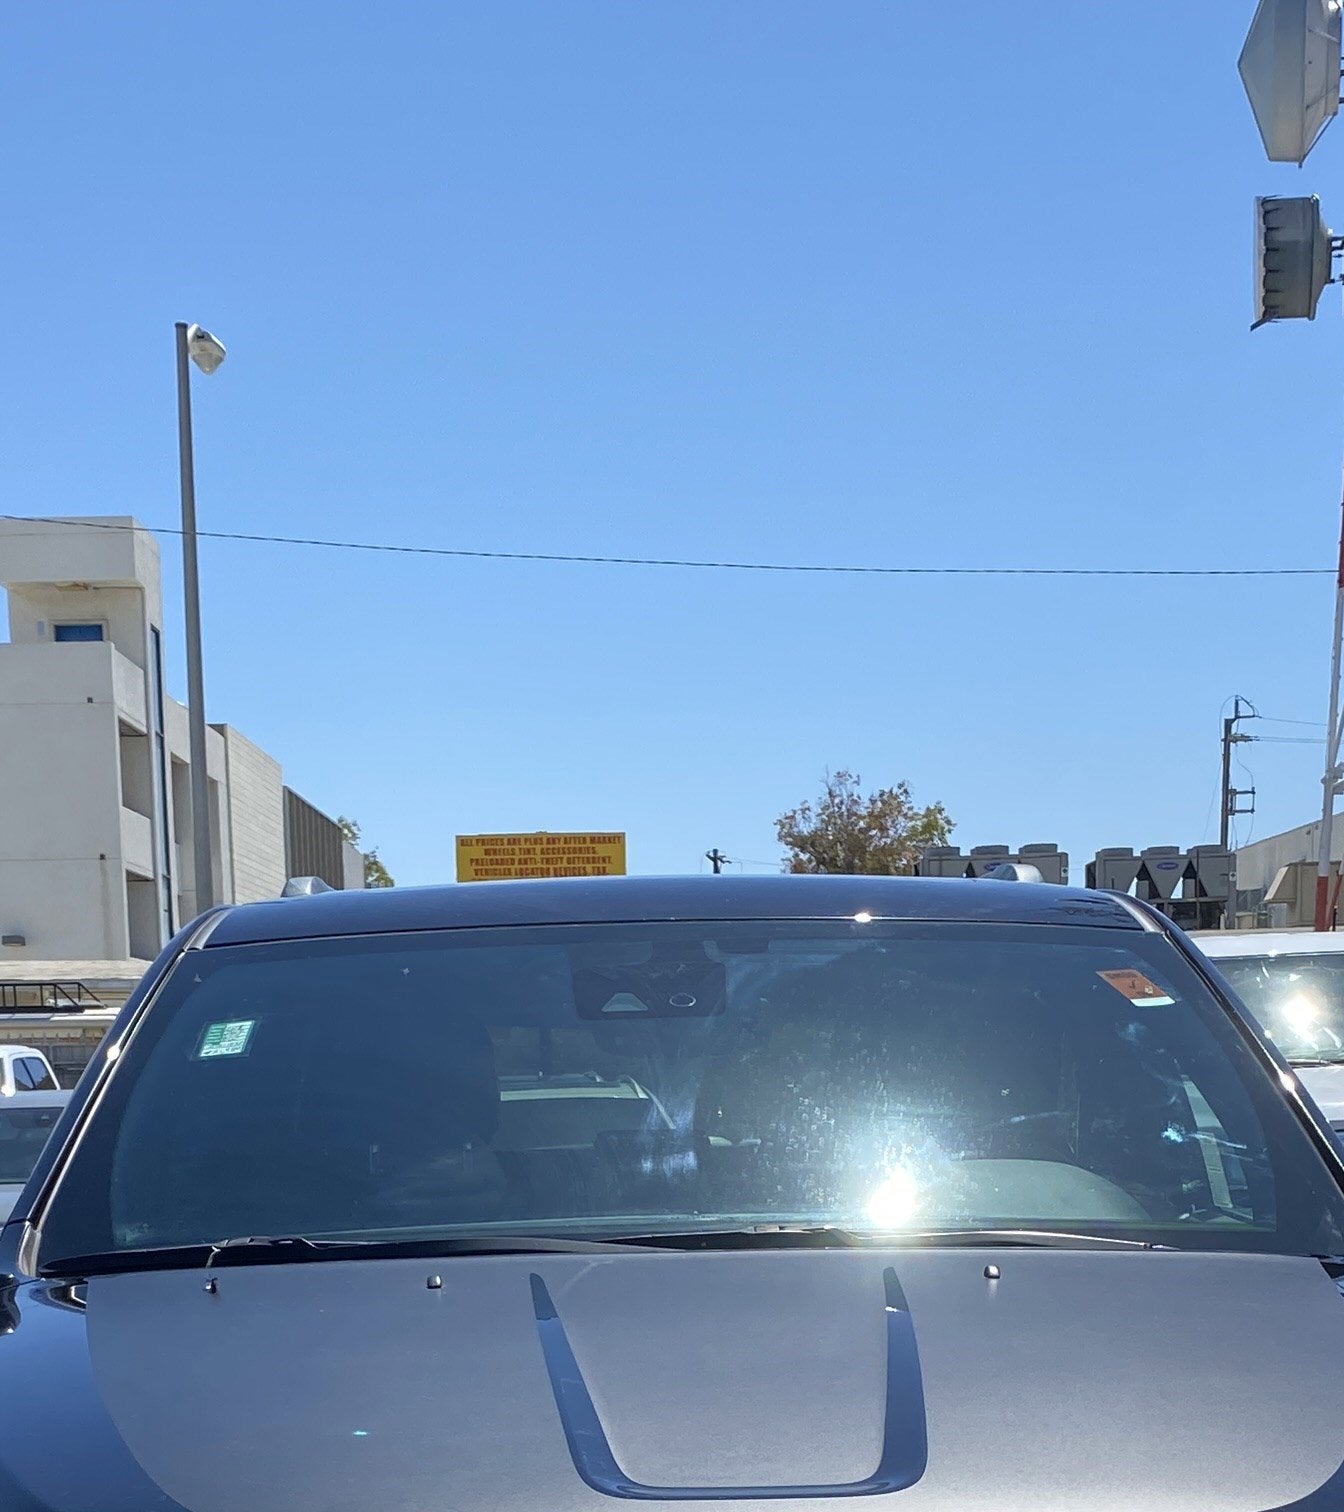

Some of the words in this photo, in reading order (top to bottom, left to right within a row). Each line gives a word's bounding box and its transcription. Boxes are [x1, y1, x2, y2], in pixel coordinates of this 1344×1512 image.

[475, 837, 505, 846] PRICES
[506, 837, 522, 846] ARE
[523, 837, 544, 845] PLUS
[546, 837, 561, 845] ANY
[563, 836, 587, 845] AFTER
[589, 836, 622, 844] MARKET
[470, 857, 516, 866] PRELOADED
[517, 856, 564, 866] ANTI-THEFT
[474, 867, 513, 876] VEHICLES
[514, 867, 550, 876] LOCATOR
